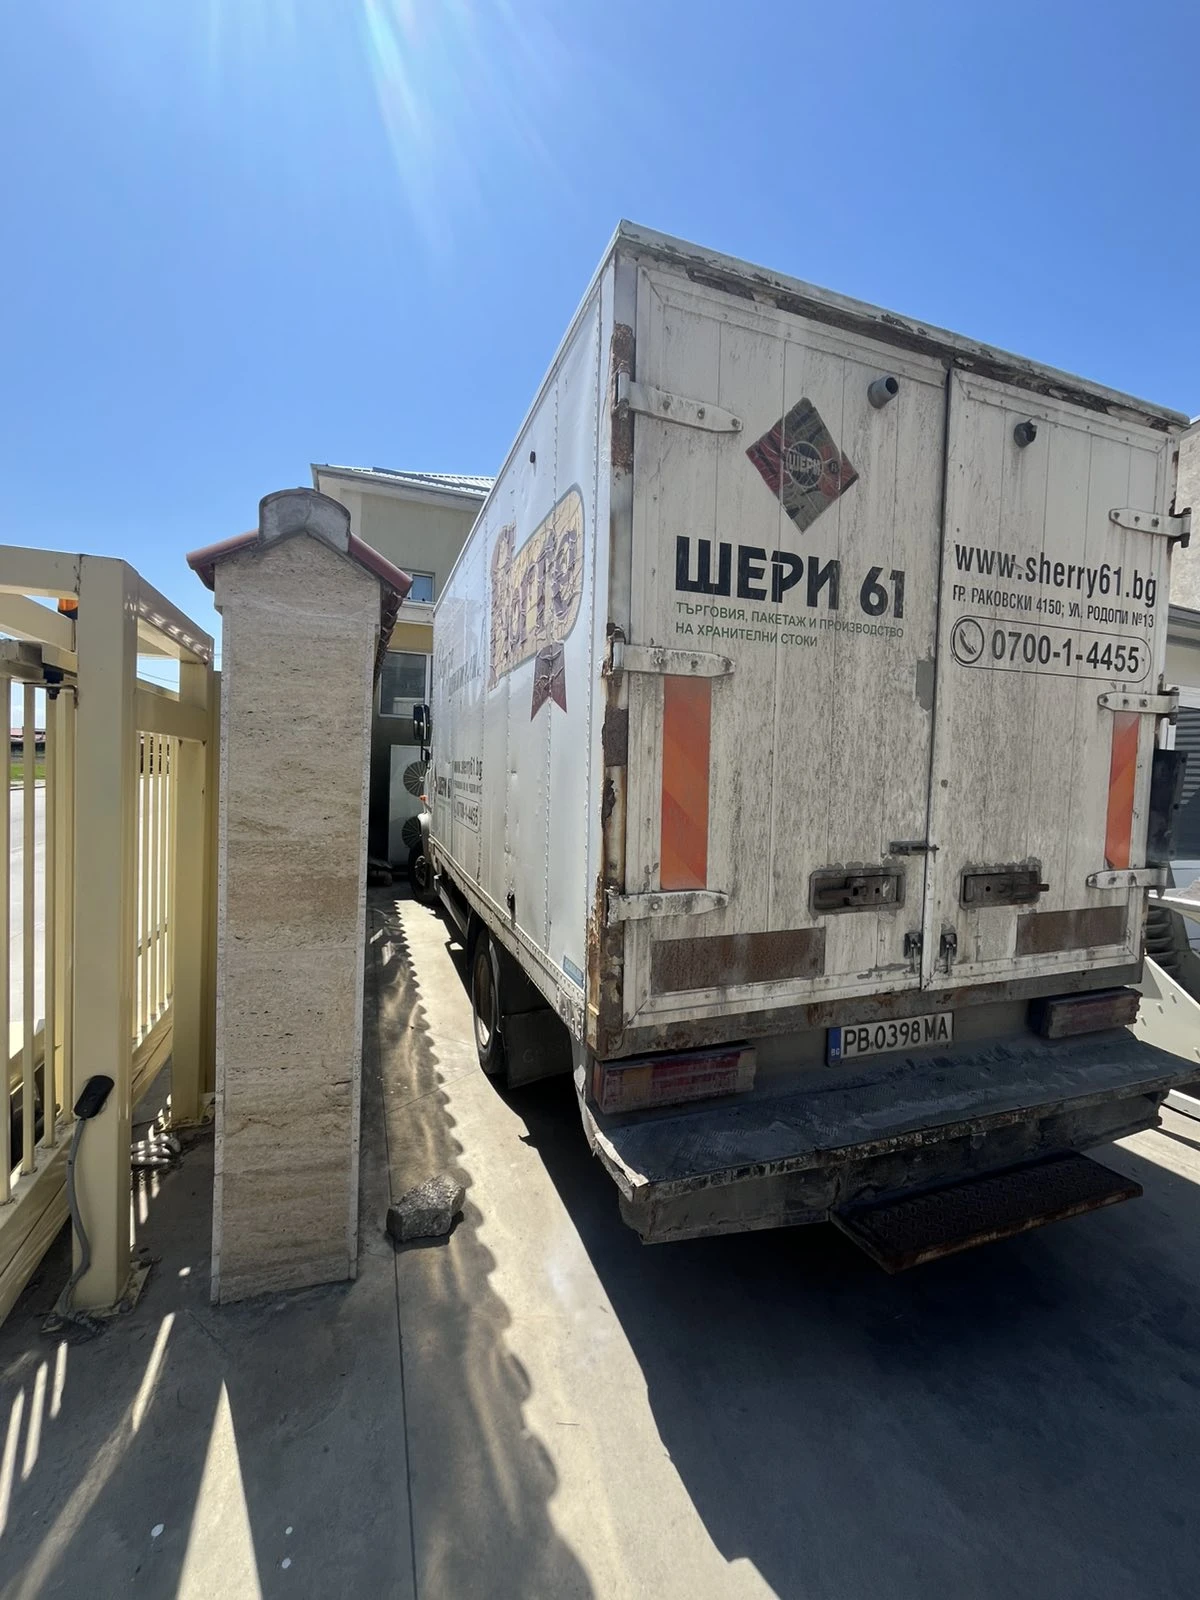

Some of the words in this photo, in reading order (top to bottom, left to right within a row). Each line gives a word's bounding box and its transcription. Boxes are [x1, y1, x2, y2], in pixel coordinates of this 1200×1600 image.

[675, 535, 840, 610] ШЕРИ
[860, 566, 905, 619] 61
[955, 543, 1157, 609] www.sherry61.bg
[676, 601, 748, 623] ТЪРГОВИЯ,
[752, 611, 806, 628] ПАКЕТАЖ
[809, 618, 817, 629] И
[819, 618, 904, 638] ПРОИЗВОДСТВО
[971, 587, 1032, 612] РАКОВСКИ
[1087, 605, 1129, 625] РОДОПИ
[675, 622, 694, 635] НА
[697, 624, 777, 643] ХРАНИТЕЛНИ
[781, 633, 818, 647] СТОКИ
[991, 629, 1140, 674] 0700-1-4455
